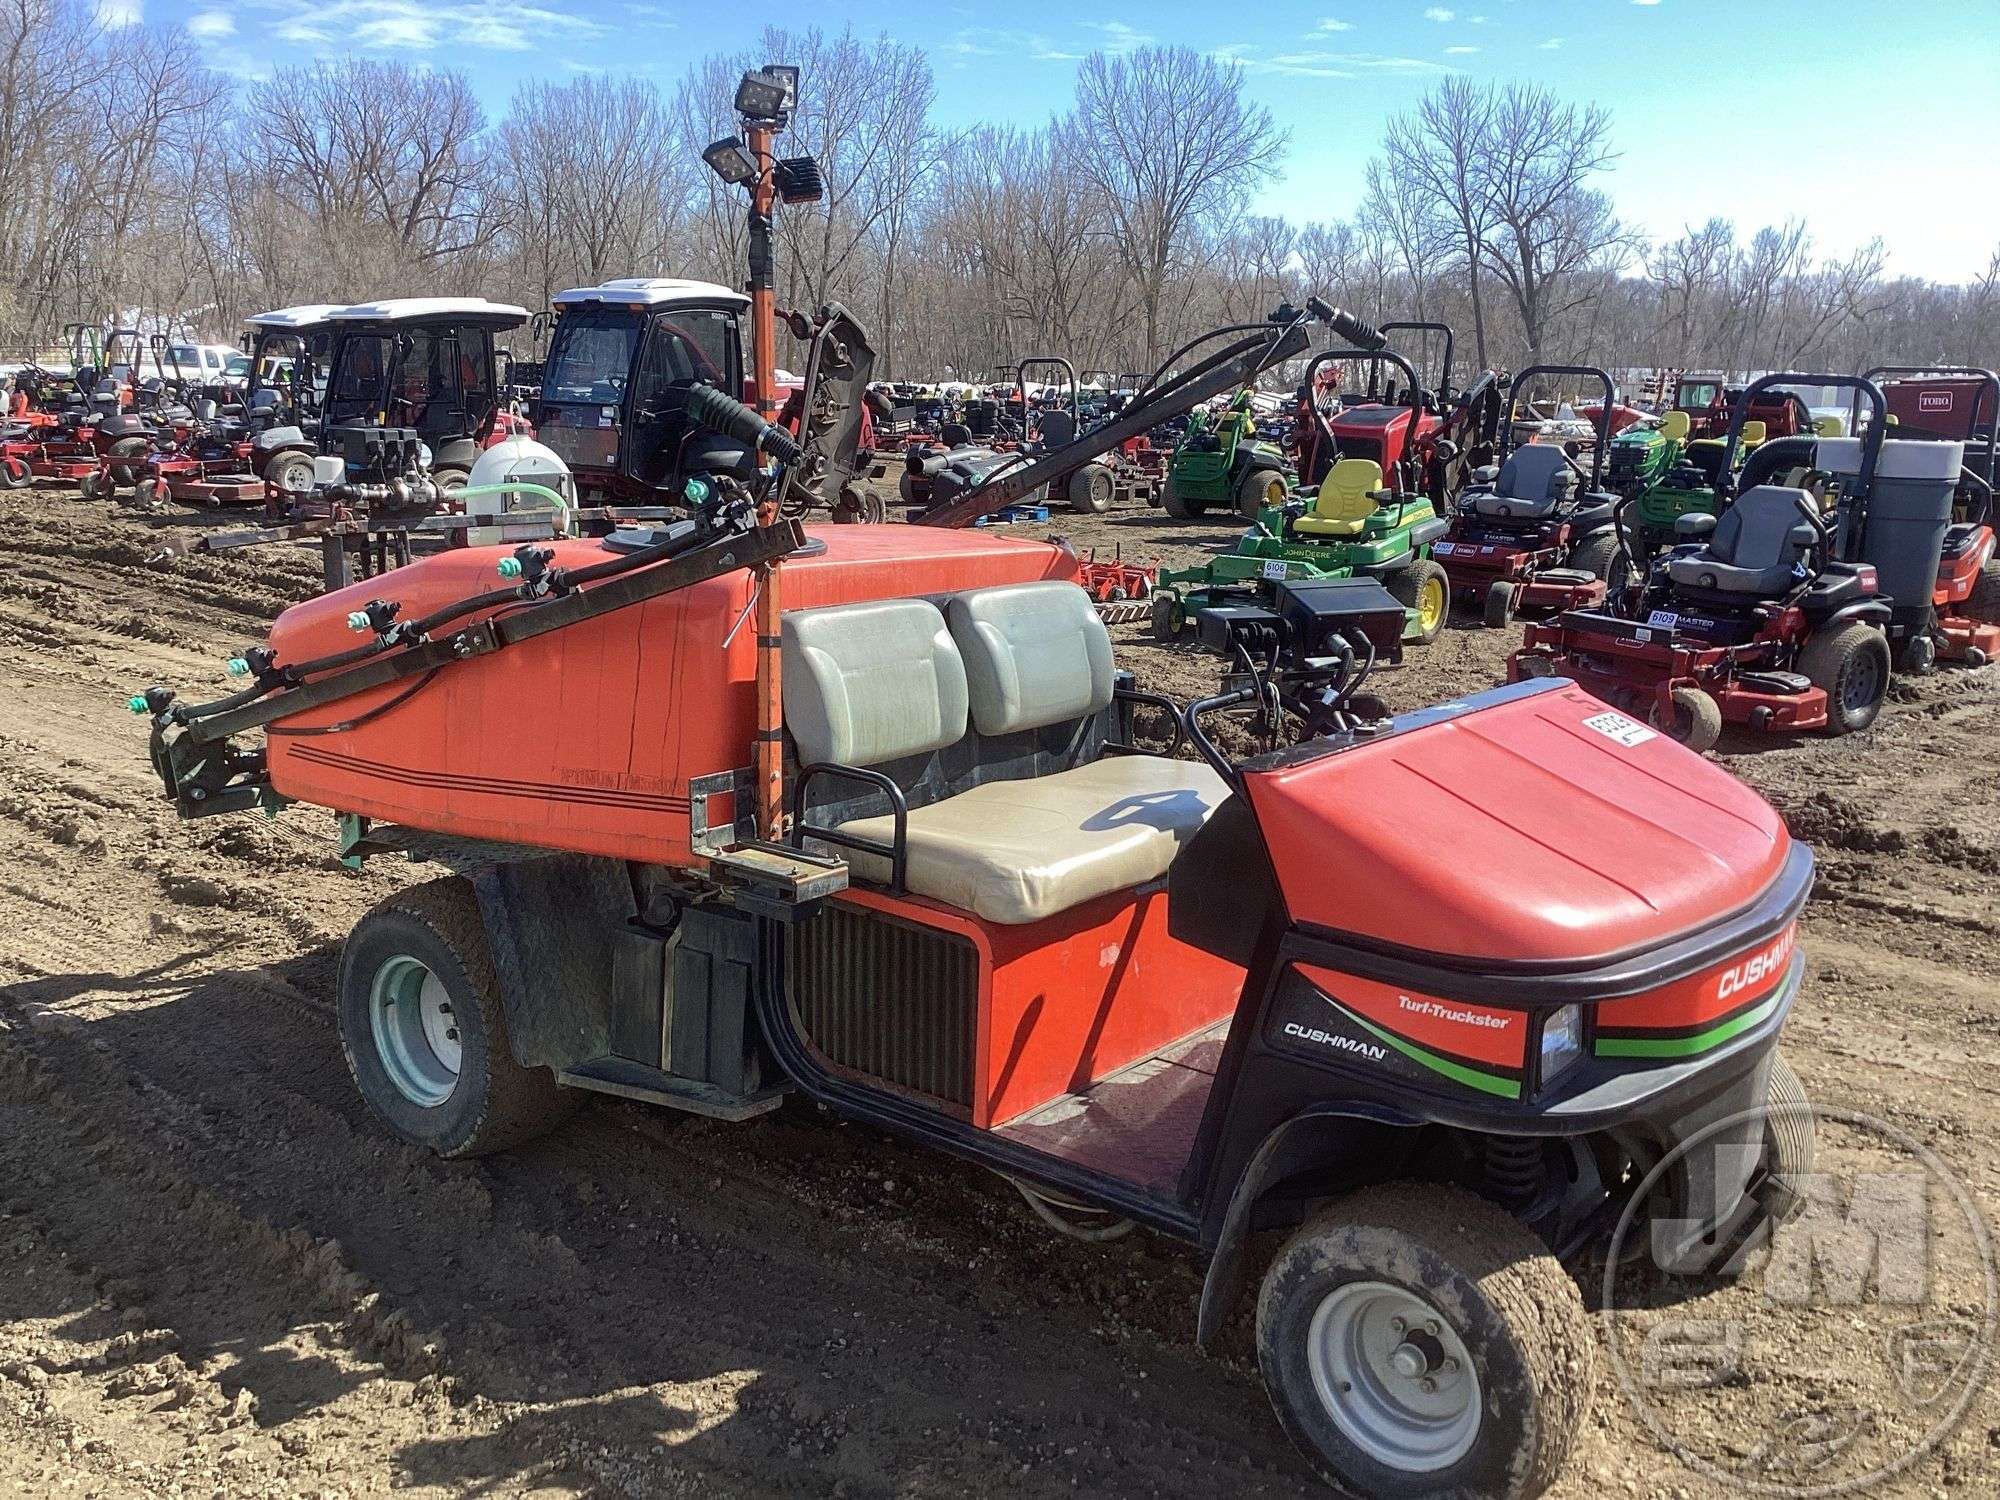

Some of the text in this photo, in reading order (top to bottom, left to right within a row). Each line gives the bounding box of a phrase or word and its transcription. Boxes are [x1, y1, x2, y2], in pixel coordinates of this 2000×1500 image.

[1922, 397, 1949, 406] TORO
[1266, 562, 1285, 573] 6106
[1652, 612, 1675, 624] 6109
[1677, 615, 1715, 628] MASTER
[1399, 995, 1509, 1029] Turf-Truckster
[1284, 1022, 1386, 1060] CUSHMAN
